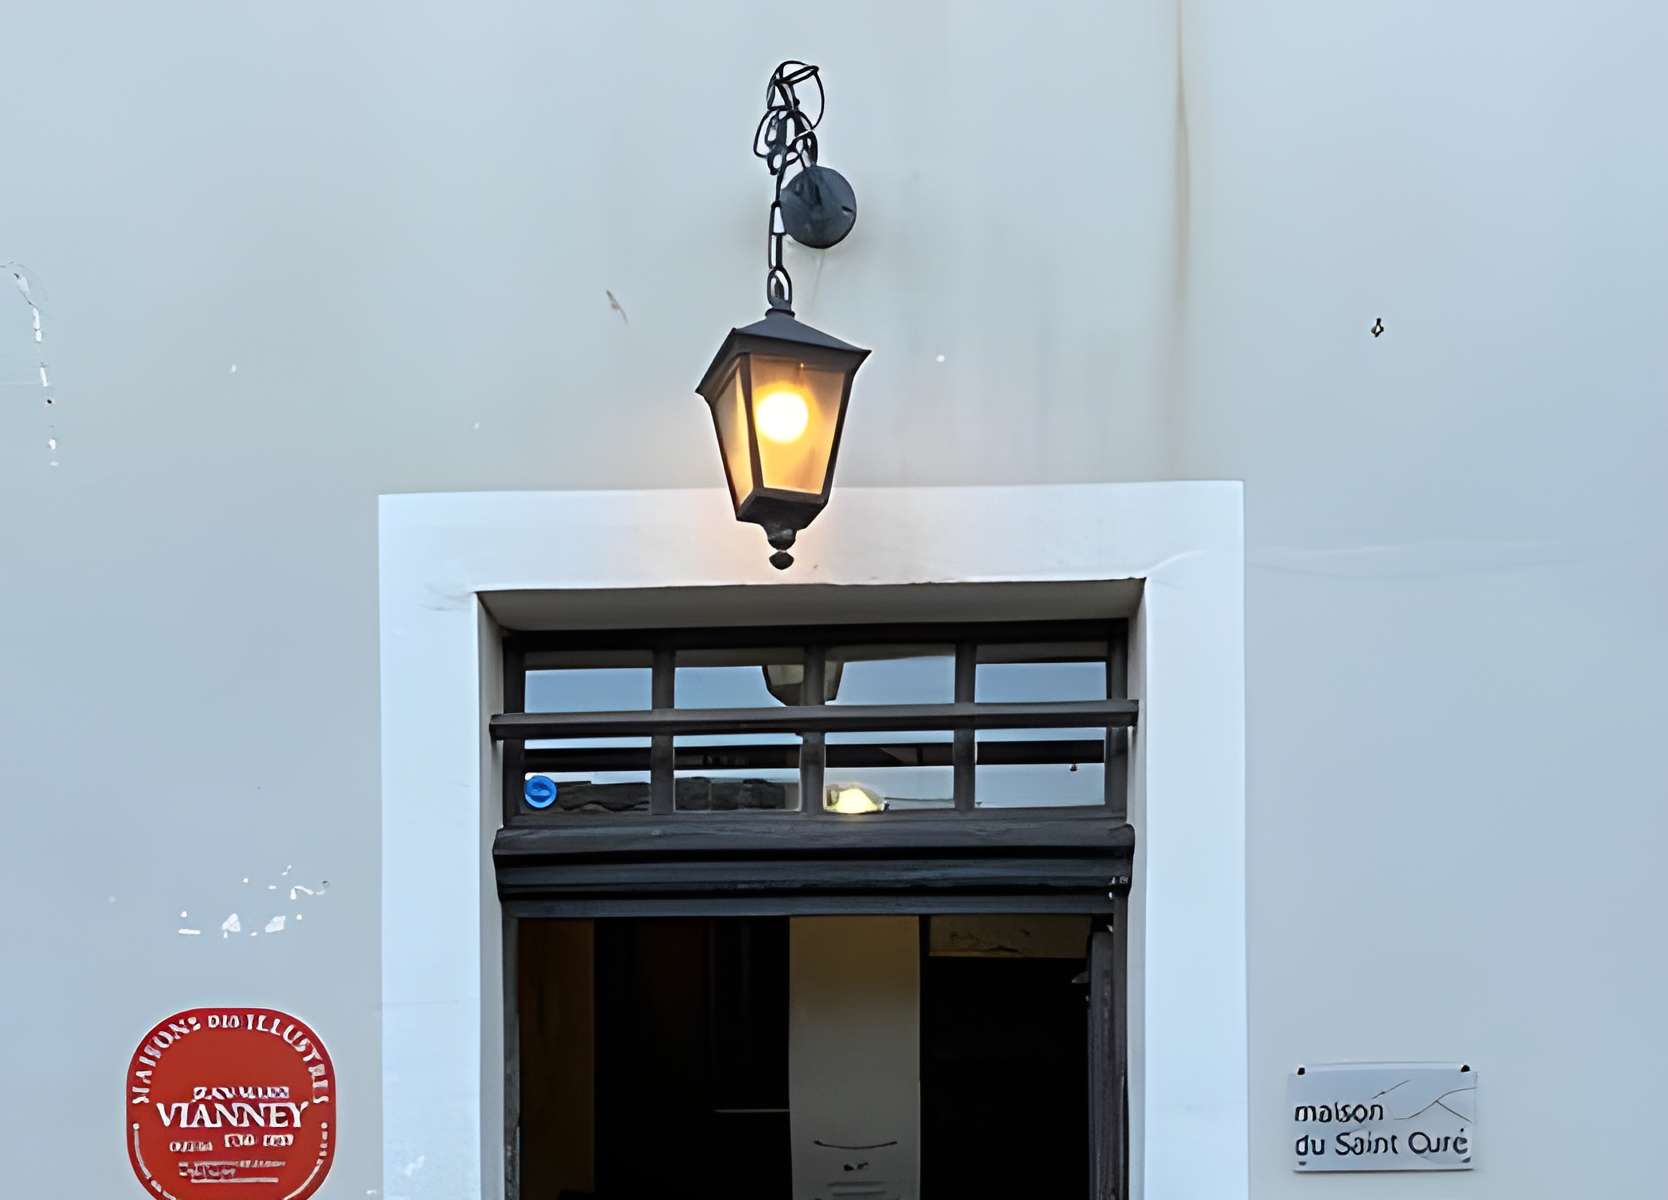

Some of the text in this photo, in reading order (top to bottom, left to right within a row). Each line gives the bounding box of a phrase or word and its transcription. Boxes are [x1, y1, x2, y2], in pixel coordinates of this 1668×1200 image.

[156, 1101, 309, 1128] VIANNEY
[1294, 1102, 1384, 1124] maison
[1295, 1134, 1326, 1156] du
[1335, 1131, 1399, 1156] Saint
